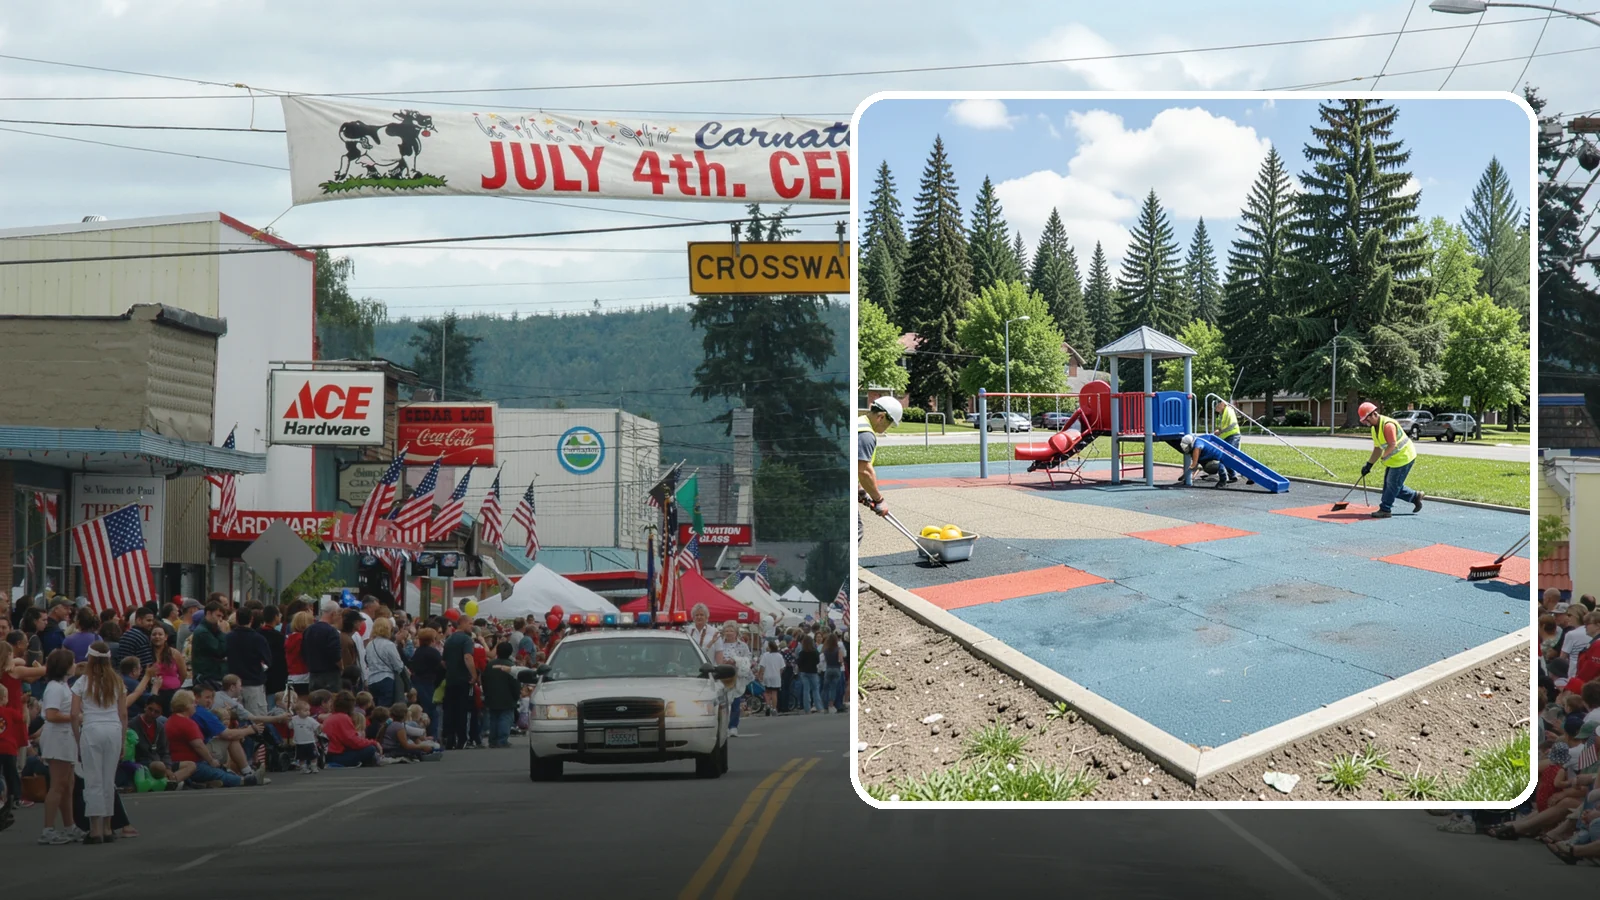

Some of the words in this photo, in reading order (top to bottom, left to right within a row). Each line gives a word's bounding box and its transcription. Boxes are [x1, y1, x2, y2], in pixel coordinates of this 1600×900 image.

[481, 140, 605, 192] JULY
[632, 149, 746, 198] 4th.
[697, 254, 850, 280] CROSSWA
[283, 380, 373, 420] ACE
[405, 409, 453, 421] CEDAR
[283, 421, 371, 436] Hardware
[416, 428, 477, 447] Coca-Cola
[353, 467, 386, 481] Simpl
[83, 485, 93, 494] St.
[96, 485, 125, 494] Vincent
[126, 486, 136, 494] de
[137, 486, 155, 495] Paul
[81, 504, 154, 521] THT
[688, 526, 741, 535] CRNATION
[699, 535, 730, 543] GLASS
